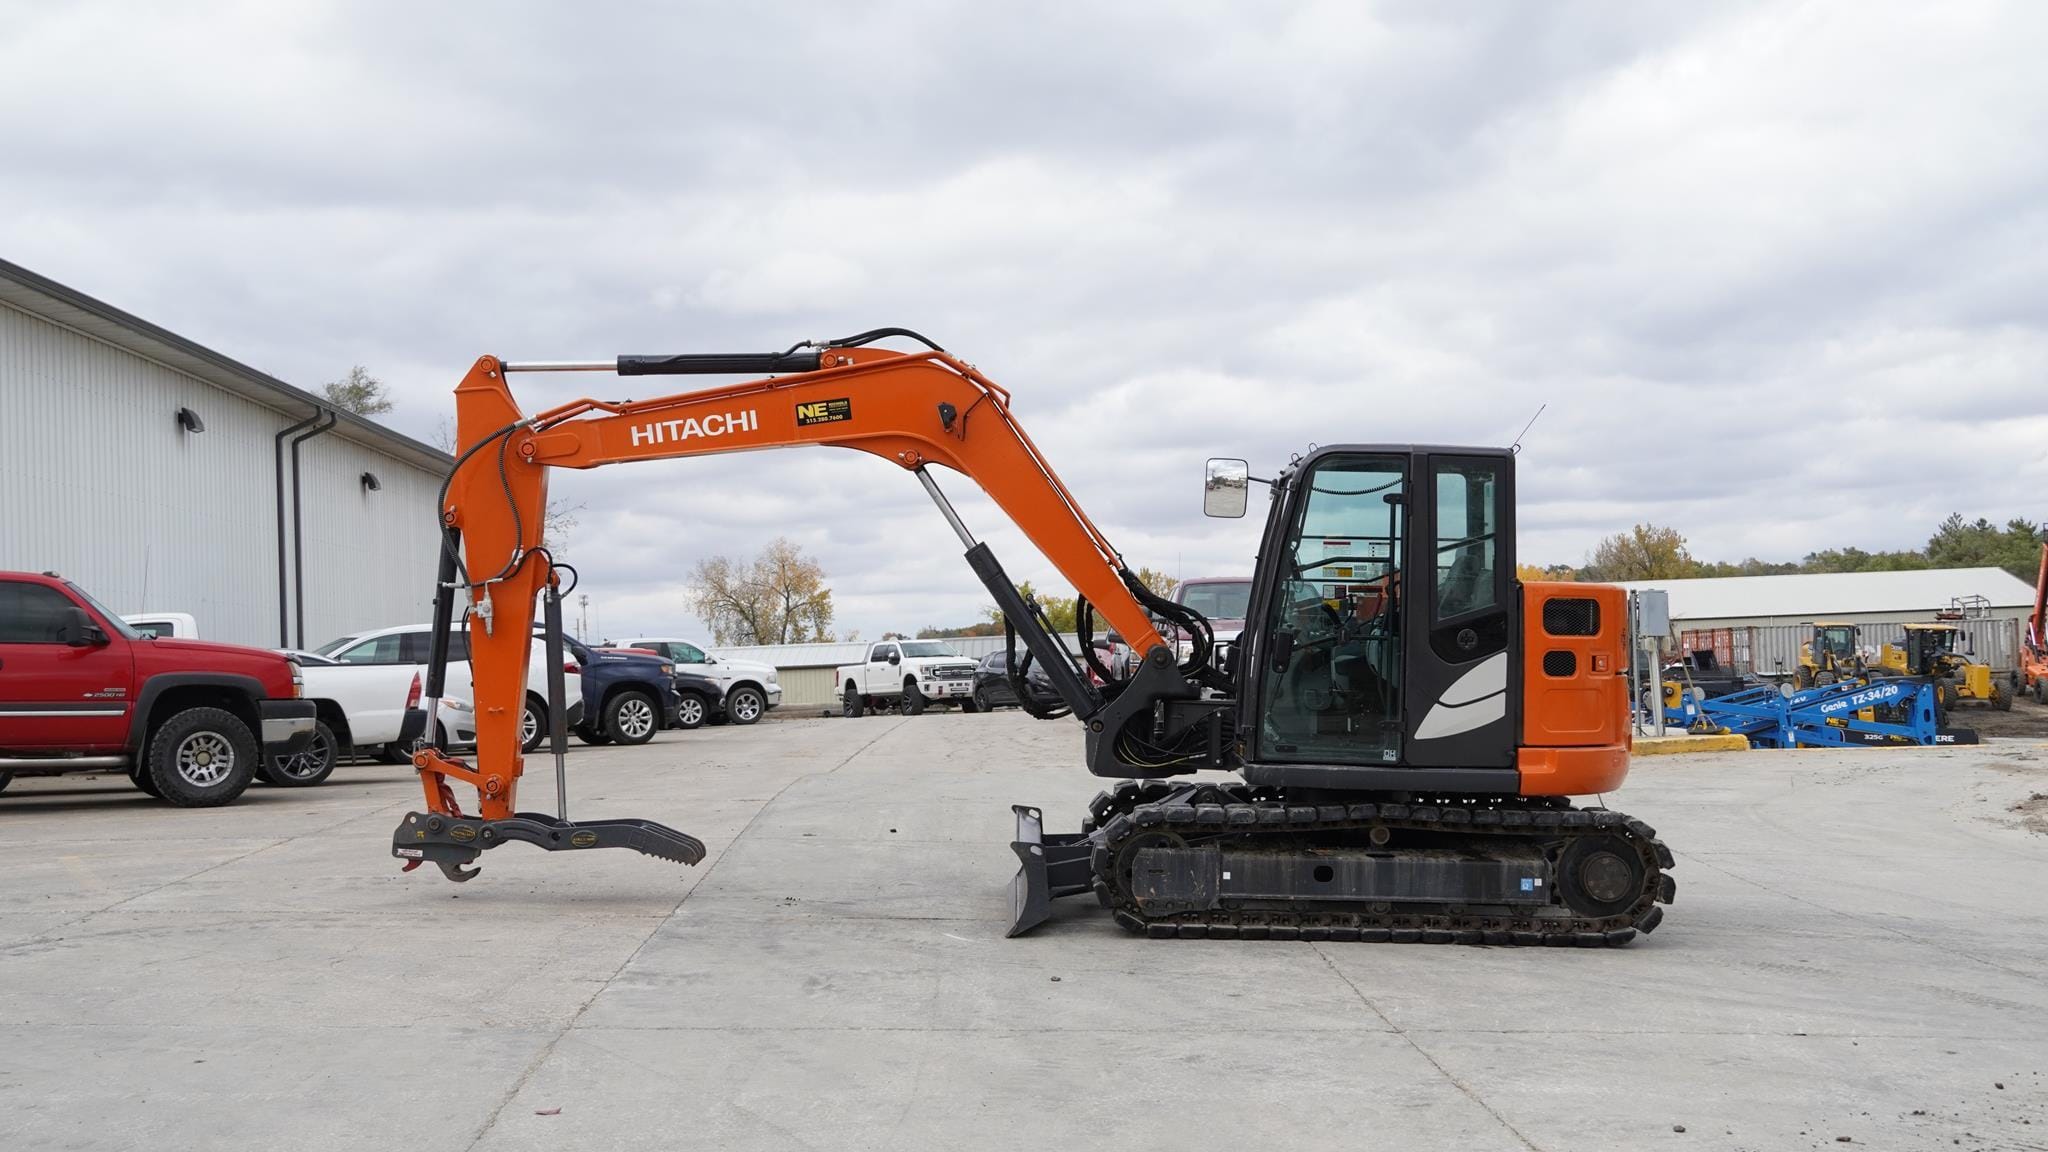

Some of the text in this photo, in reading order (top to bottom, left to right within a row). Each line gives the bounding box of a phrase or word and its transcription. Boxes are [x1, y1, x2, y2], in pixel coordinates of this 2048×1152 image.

[797, 402, 828, 419] NE
[631, 410, 758, 446] HITACHI
[1821, 685, 1898, 713] Genie TZ-34/20
